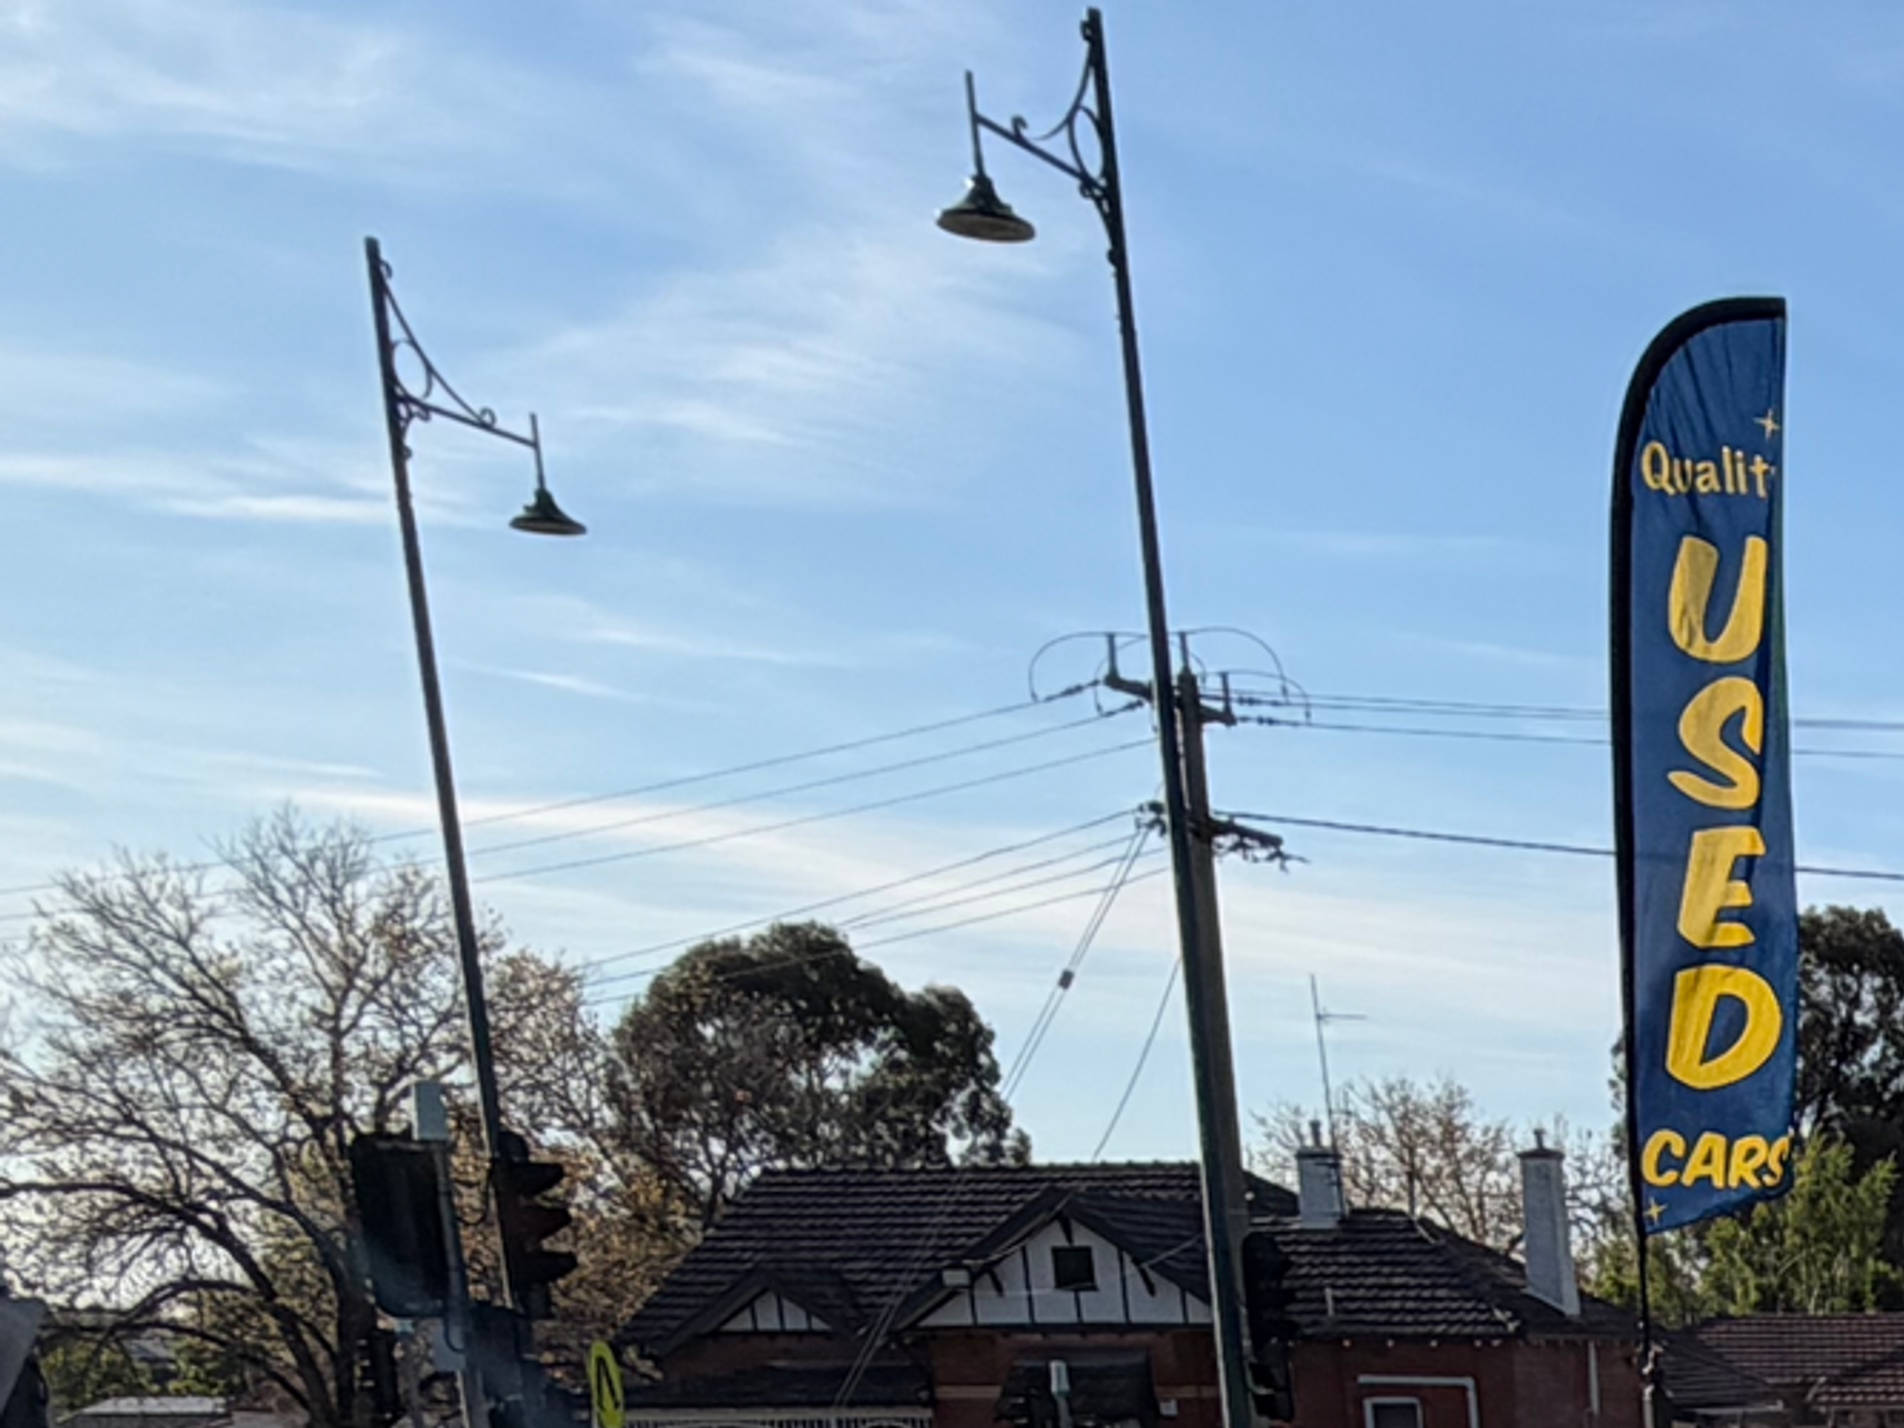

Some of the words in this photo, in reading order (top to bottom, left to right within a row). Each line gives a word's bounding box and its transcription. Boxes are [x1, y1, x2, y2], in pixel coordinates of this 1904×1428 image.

[1641, 440, 1775, 498] Qualit
[1666, 535, 1783, 1090] USED
[1642, 1127, 1792, 1189] CARS
